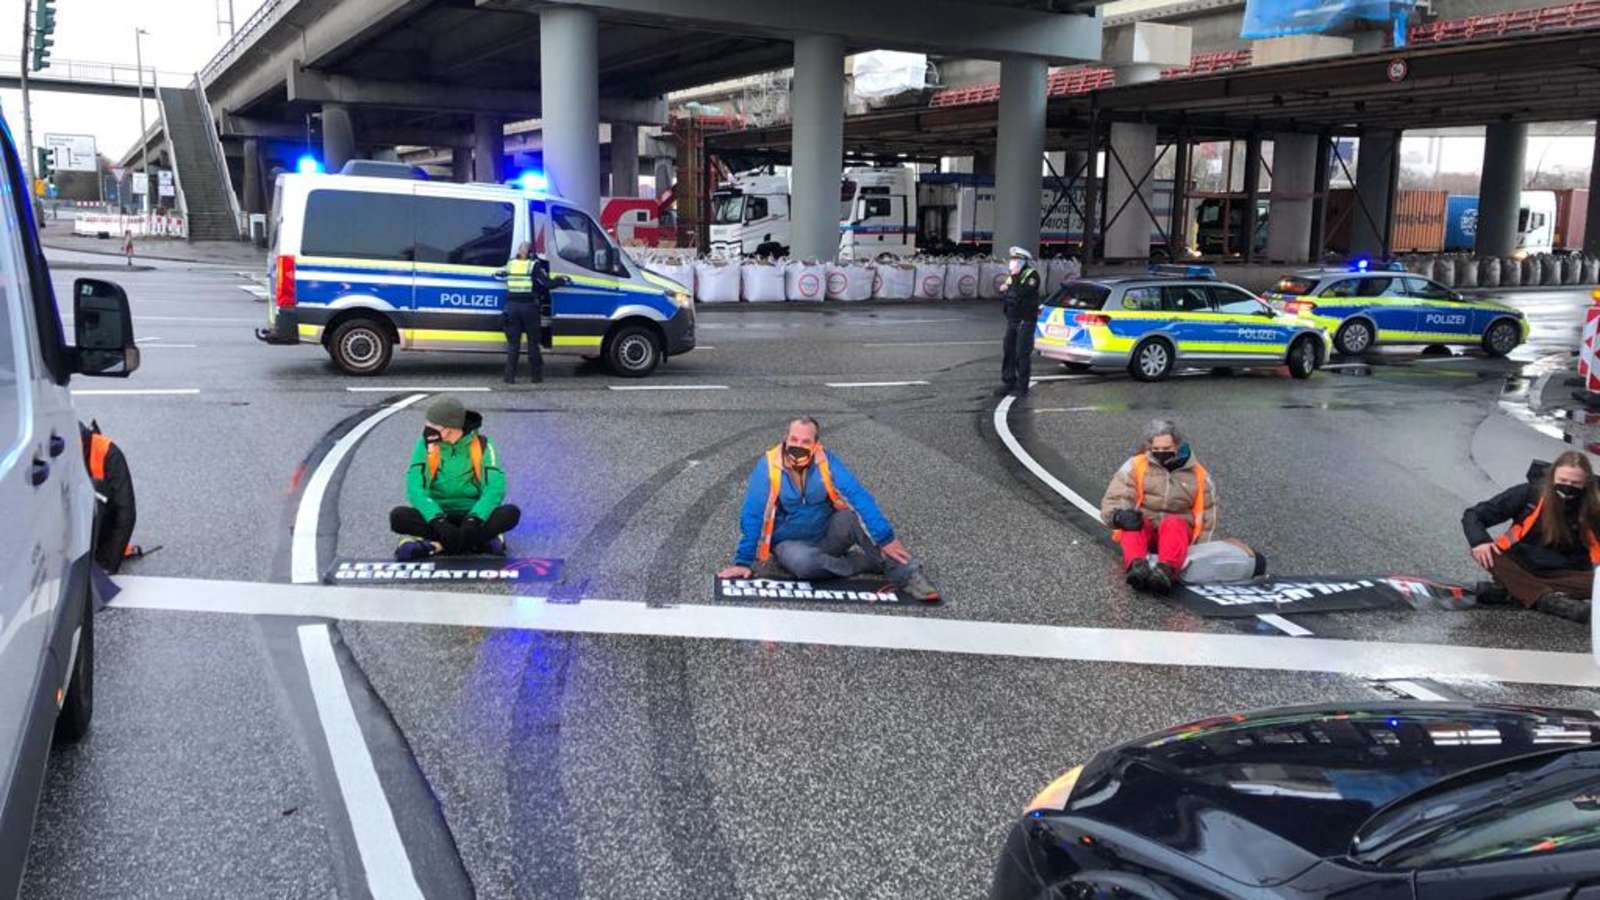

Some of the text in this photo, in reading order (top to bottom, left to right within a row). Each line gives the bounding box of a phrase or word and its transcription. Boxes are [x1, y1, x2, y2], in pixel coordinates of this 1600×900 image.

[440, 293, 498, 307] POLIZEI
[1426, 313, 1466, 326] POLIZEI
[1238, 328, 1277, 341] POLIZEI
[339, 561, 436, 571] LETZTE
[335, 569, 519, 579] GENERATION
[720, 578, 813, 590] LETZTE
[722, 587, 899, 601] GENERATION
